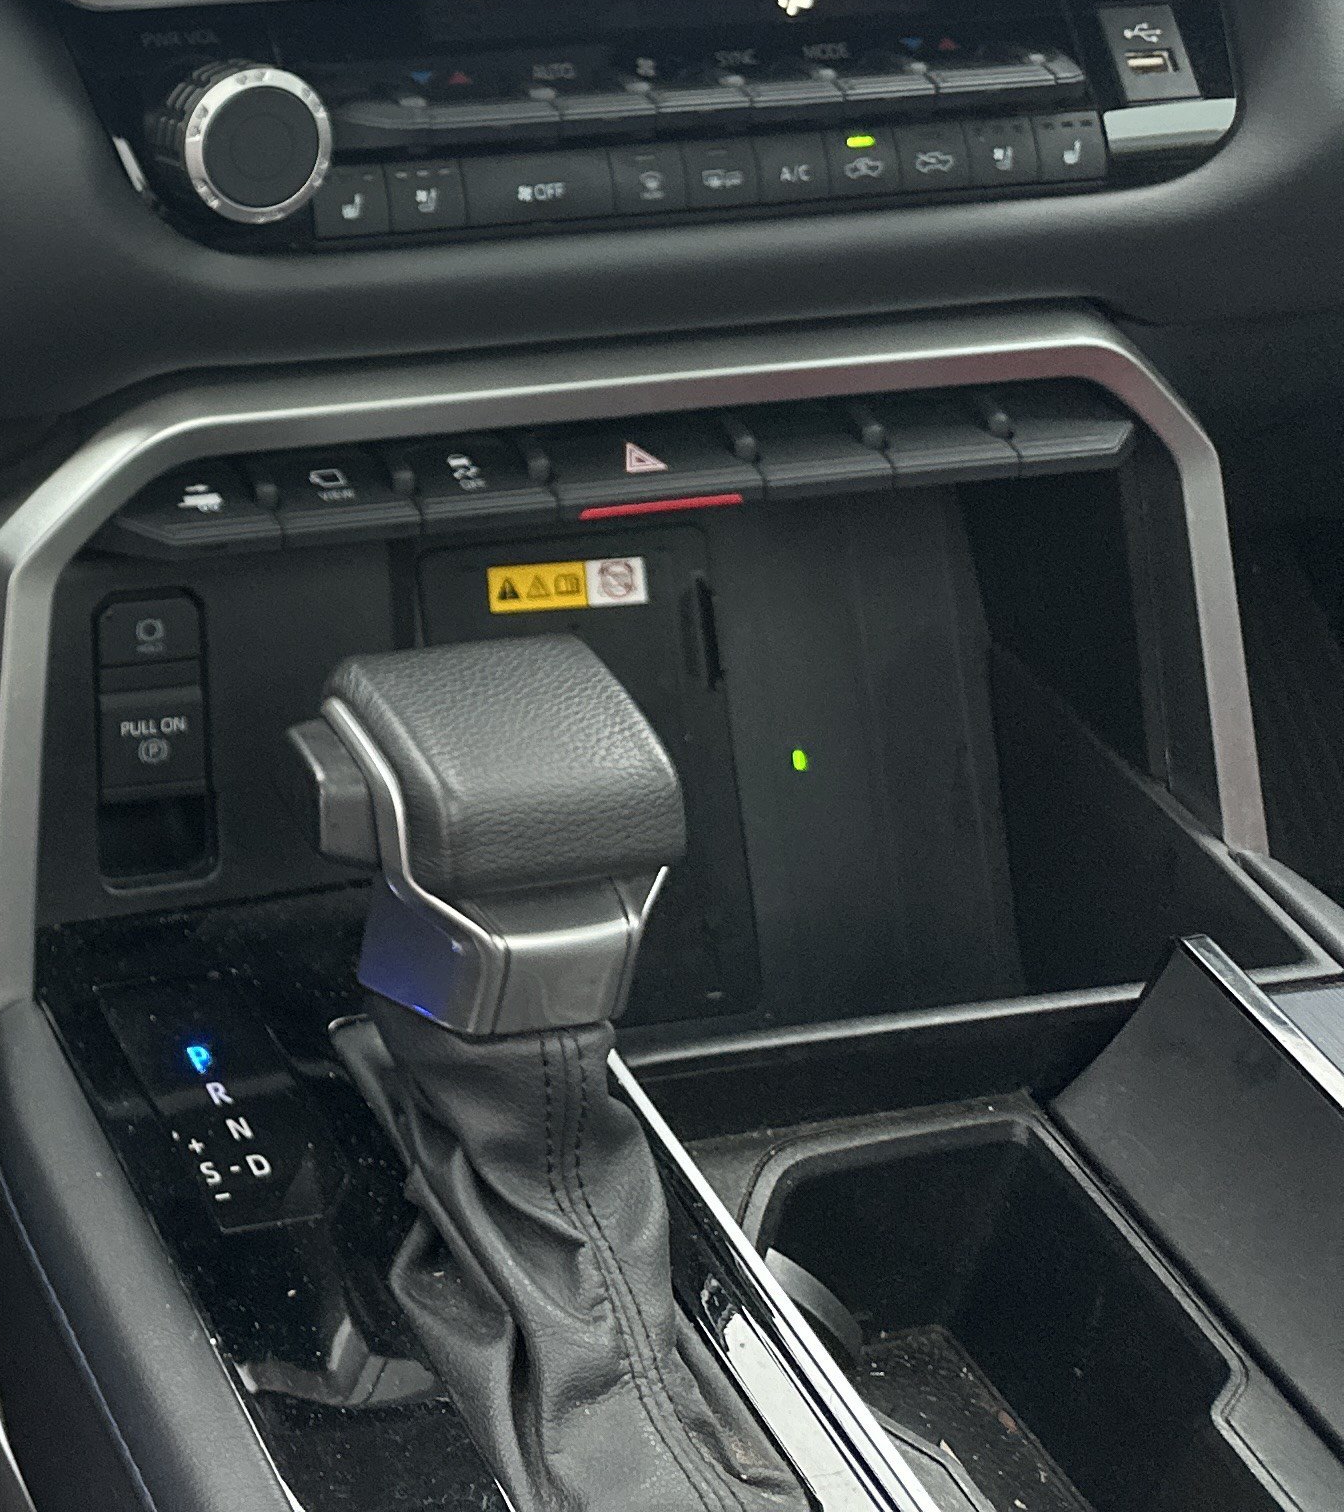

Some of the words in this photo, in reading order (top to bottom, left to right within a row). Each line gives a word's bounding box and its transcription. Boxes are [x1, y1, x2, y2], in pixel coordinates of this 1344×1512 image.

[803, 41, 849, 61] MODE
[780, 164, 811, 183] A/C
[534, 181, 565, 200] OFF
[120, 719, 156, 737] PULL
[160, 716, 187, 733] ON
[186, 1046, 212, 1074] P
[206, 1081, 234, 1106] R
[225, 1116, 255, 1141] N
[199, 1161, 222, 1185] S
[246, 1153, 272, 1178] D
